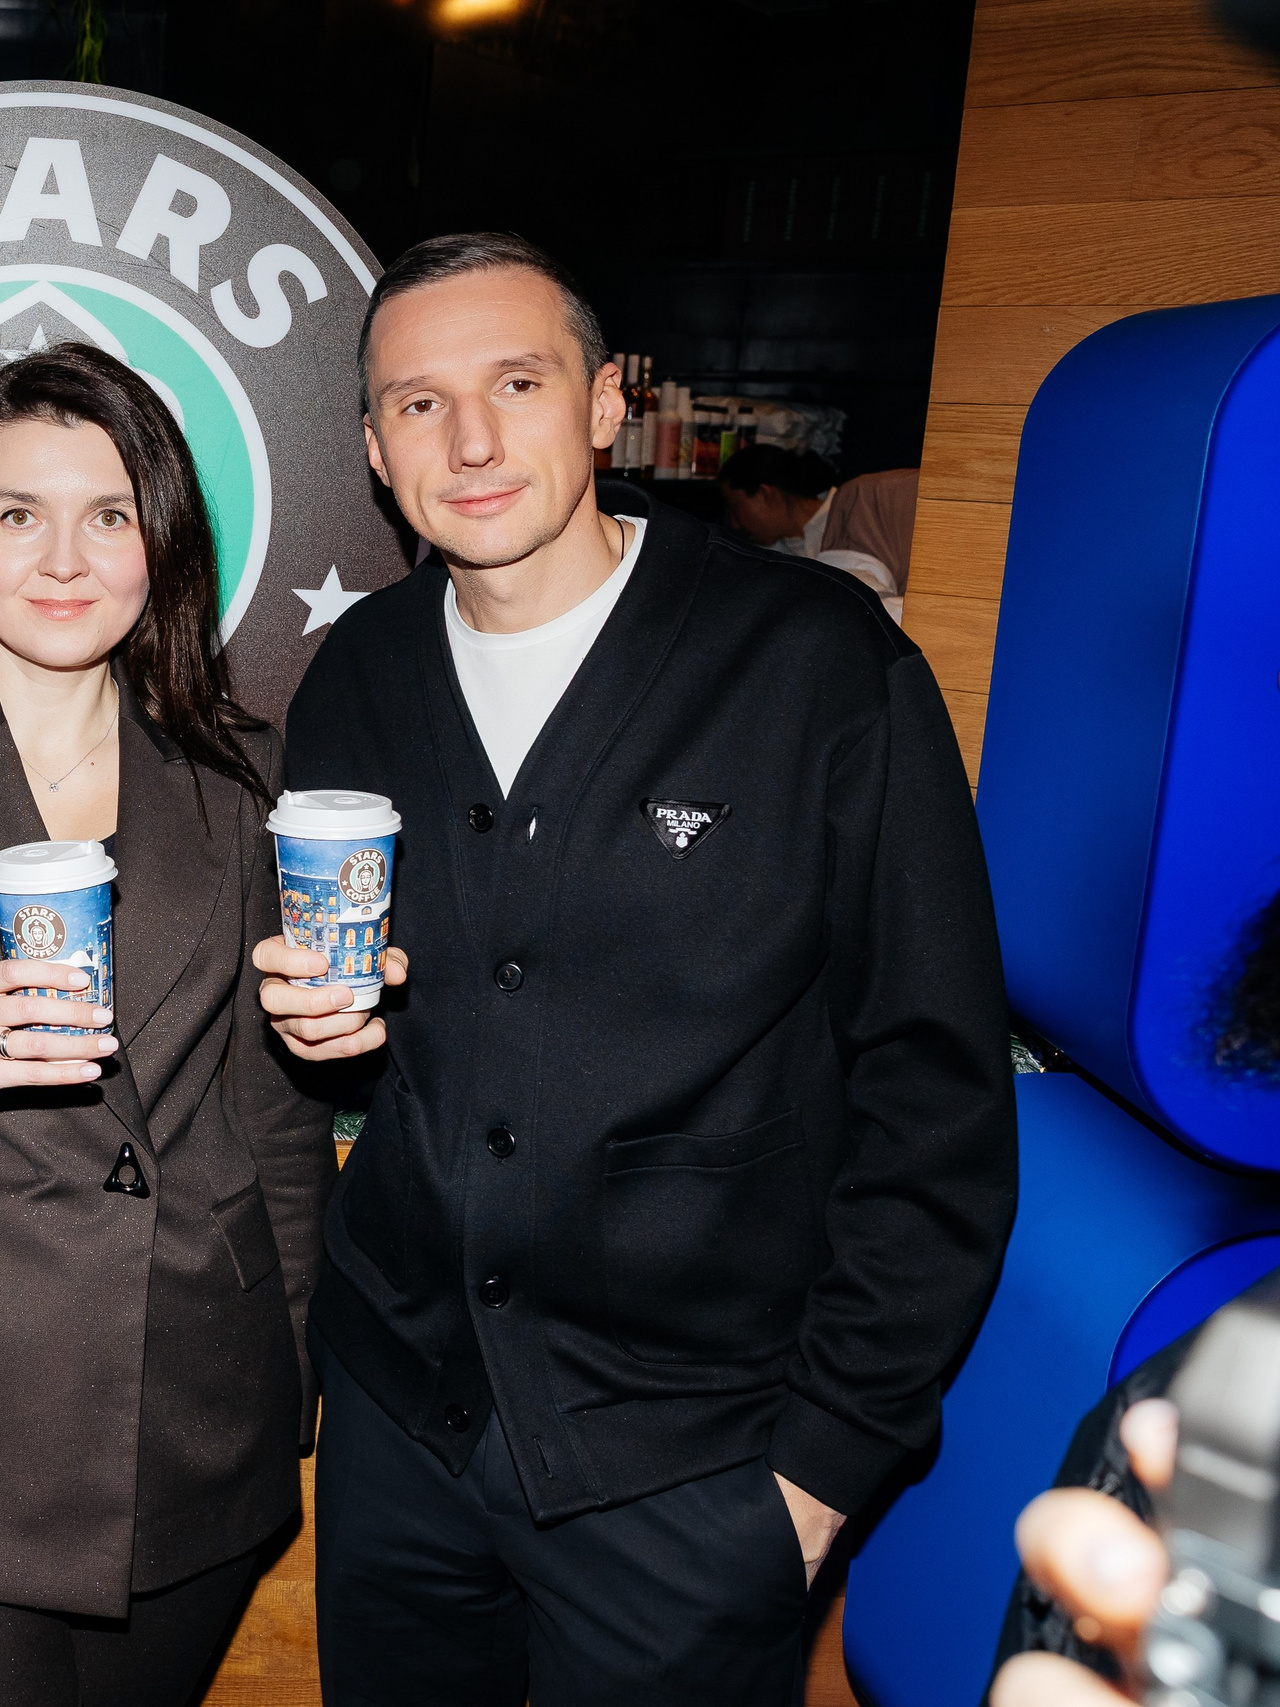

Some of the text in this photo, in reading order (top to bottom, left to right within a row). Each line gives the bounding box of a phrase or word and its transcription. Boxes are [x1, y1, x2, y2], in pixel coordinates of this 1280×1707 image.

[655, 808, 713, 823] PRADA
[666, 819, 701, 829] MILANO
[349, 851, 383, 866] STARS
[345, 886, 381, 903] COFFEE
[18, 907, 57, 921] STARS
[20, 942, 60, 959] COFFEE
